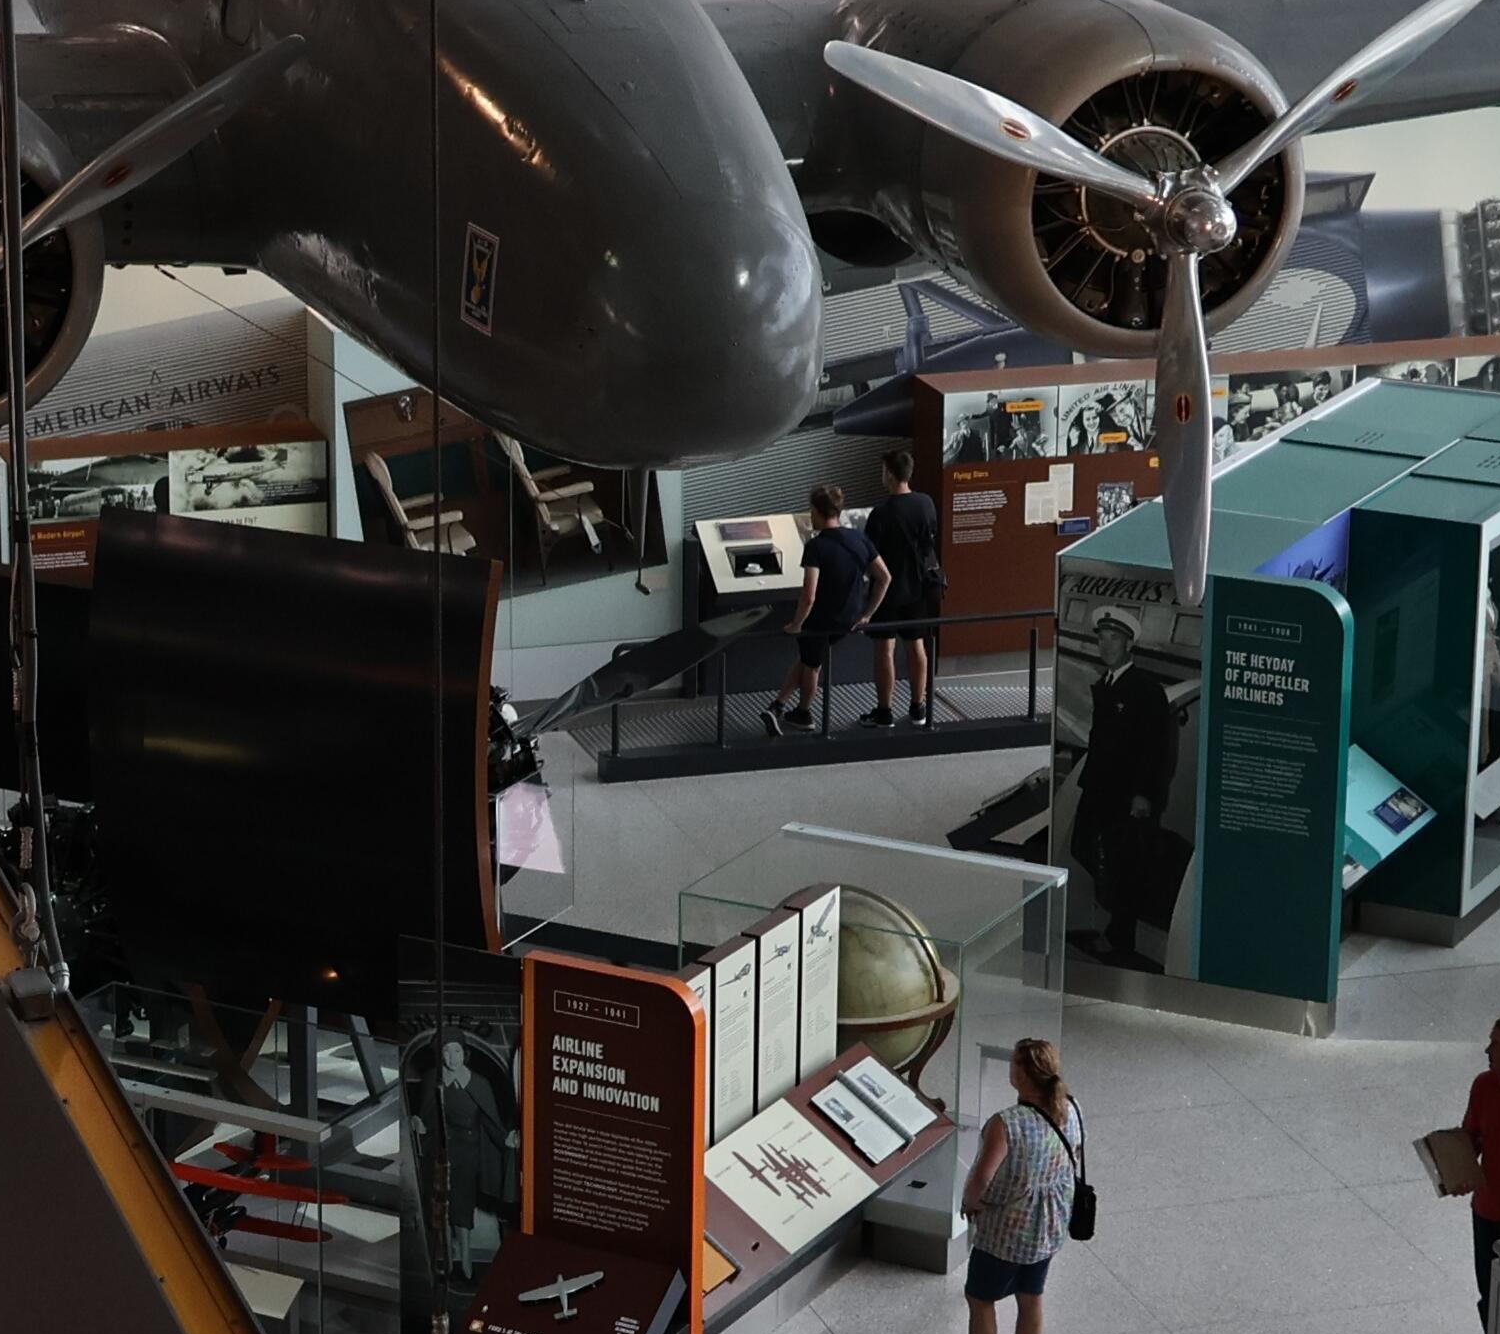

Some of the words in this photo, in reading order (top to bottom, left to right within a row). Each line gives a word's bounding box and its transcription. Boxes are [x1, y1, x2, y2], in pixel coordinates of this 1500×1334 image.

[25, 391, 151, 438] MERICAN
[168, 366, 282, 407] AIRWAYS
[1061, 391, 1091, 422] UNITED
[1093, 383, 1111, 395] AIR
[1070, 574, 1174, 604] AIRWAYS
[1225, 650, 1247, 666] THE
[1250, 653, 1296, 673] HEYDAY
[1224, 667, 1239, 683] OF
[1242, 670, 1310, 694] PROPELLER
[1223, 684, 1284, 707] AIRLINERS
[567, 998, 590, 1012] 1927
[604, 1005, 628, 1020] 1941
[552, 1034, 604, 1060] AIRLINE
[552, 1054, 627, 1085] EXPANSION
[552, 1075, 579, 1096] AND
[582, 1080, 661, 1113] INNOVATION
